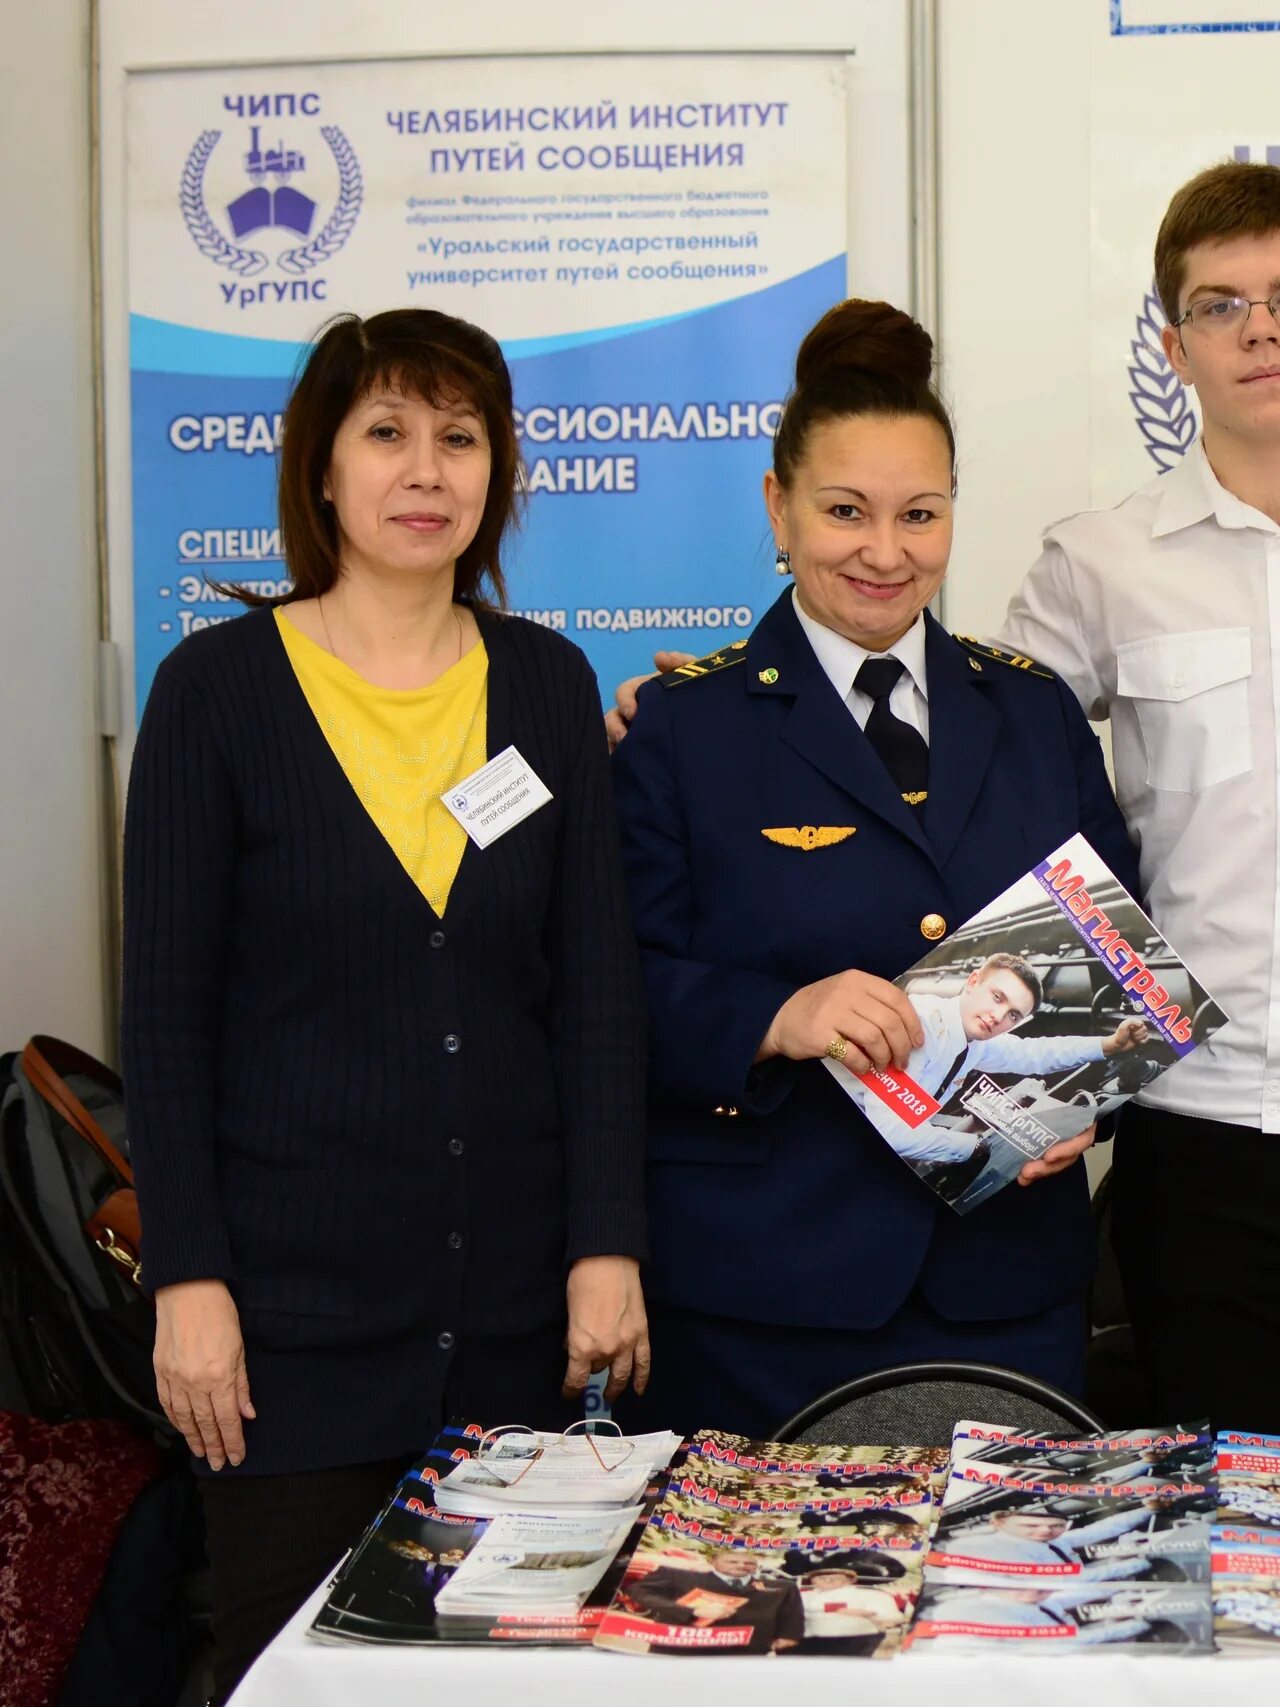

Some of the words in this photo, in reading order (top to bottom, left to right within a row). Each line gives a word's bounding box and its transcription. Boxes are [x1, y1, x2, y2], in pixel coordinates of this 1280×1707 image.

[223, 92, 321, 118] ЧИПС
[386, 101, 617, 134] ЧЕЛЯБИНСКИЙ
[630, 103, 789, 129] ИНСТИТУТ
[431, 142, 524, 173] ПУТЕЙ
[538, 143, 744, 173] СООБЩЕНИЯ
[417, 233, 550, 259] «Уральский
[559, 231, 758, 255] государственный
[407, 264, 547, 290] университет
[556, 262, 619, 287] путей
[627, 262, 768, 283] сообщения»
[220, 278, 327, 308] УрГУПС
[515, 457, 636, 492] АНИЕ
[178, 528, 286, 559] СПЕЦИ
[576, 605, 752, 633] подвижного
[466, 790, 503, 821] ЧЕЛЯБИНСКИЙ
[503, 773, 529, 797] ИНСТИТУТ
[480, 809, 499, 828] ПУТЕЙ
[499, 787, 530, 815] СООБЩЕНИЯ
[1044, 859, 1192, 1044] Магистраль
[896, 1087, 927, 1116] 2018
[978, 1080, 1015, 1117] ЧИПС
[1011, 1107, 1056, 1148] УрГУПС
[1011, 1130, 1039, 1153] выбор!
[969, 1428, 1198, 1450] Магистраль
[701, 1441, 934, 1474] Магистраль
[680, 1479, 923, 1511] Магистраль
[963, 1468, 1205, 1497] Магистраль
[662, 1512, 913, 1550] Магистраль
[667, 1626, 713, 1638] 100
